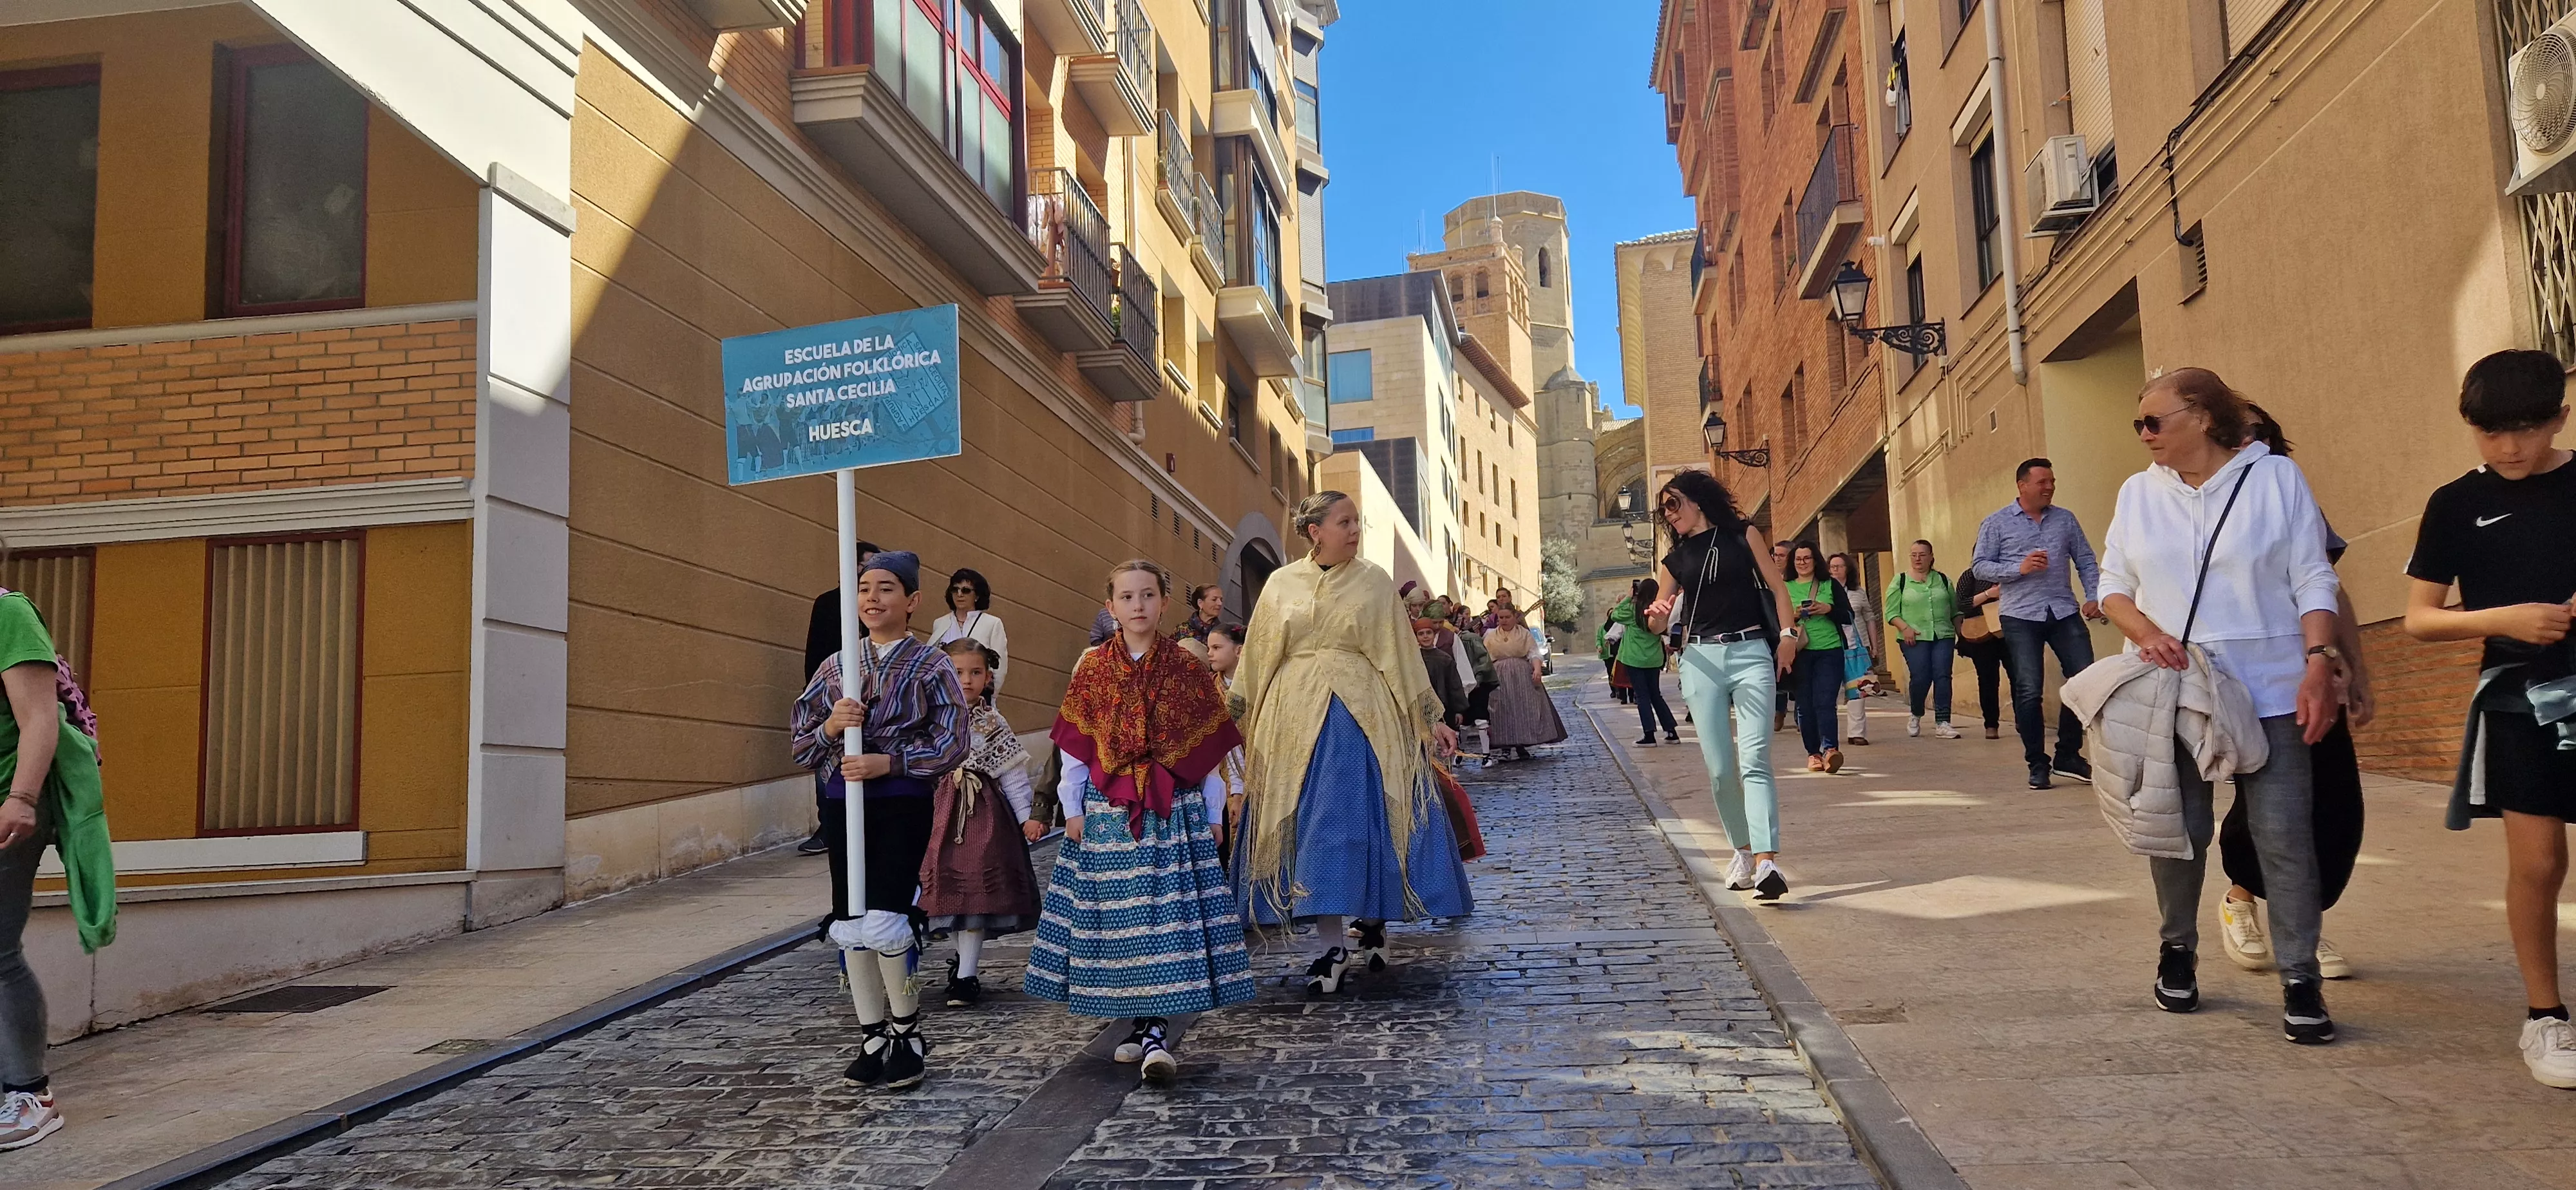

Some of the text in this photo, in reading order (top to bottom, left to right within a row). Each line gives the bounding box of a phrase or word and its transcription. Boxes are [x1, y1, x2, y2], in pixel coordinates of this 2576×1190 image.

[785, 334, 895, 364] ESCUELA DE LA
[743, 350, 942, 393] AGRUPACIÓN FOLKLÓRICA
[786, 379, 896, 408] SANTA CECILIA
[909, 397, 940, 423] HUESCA
[809, 418, 873, 442] HUESCA
